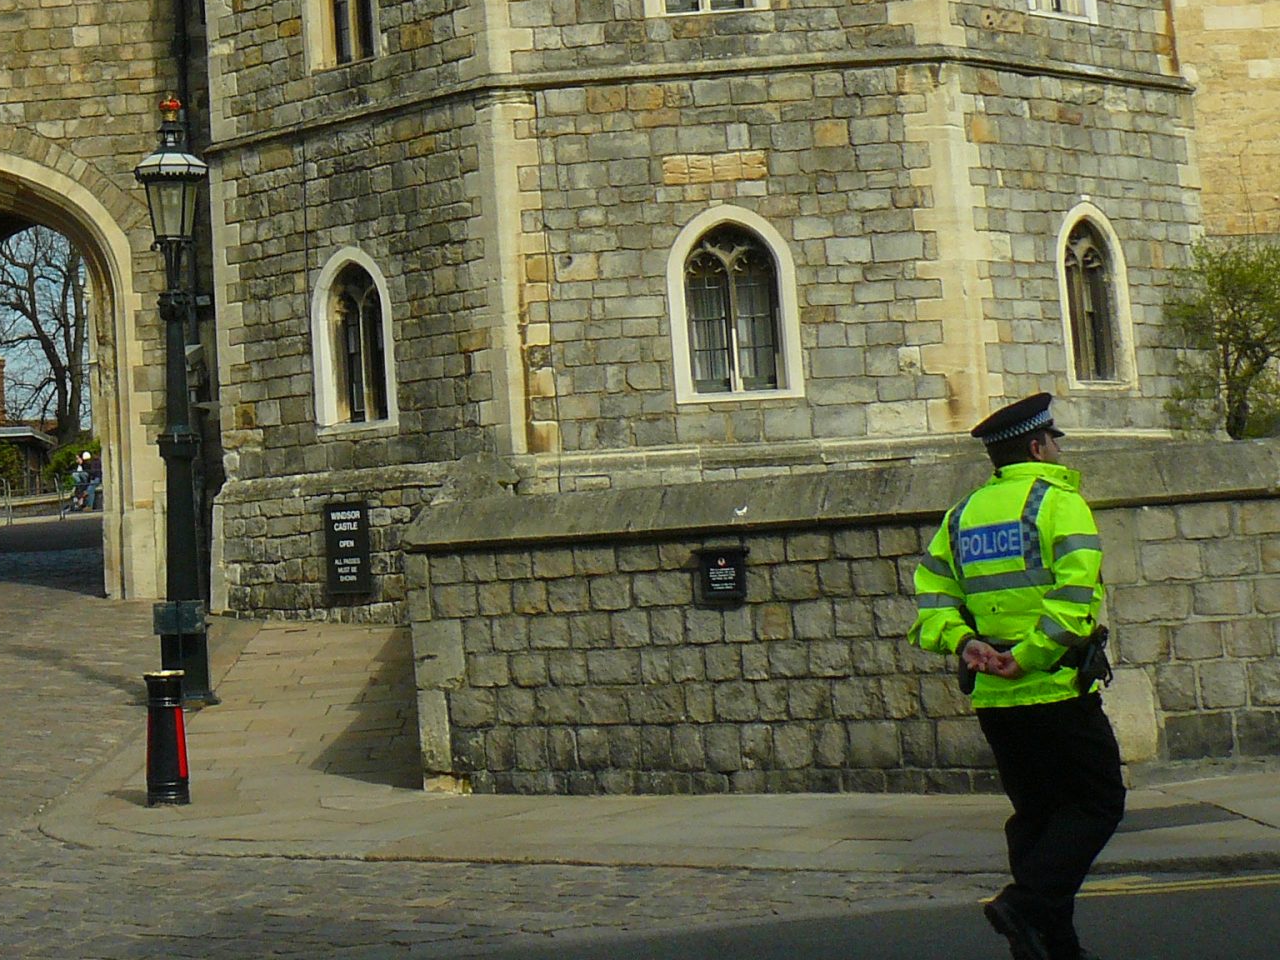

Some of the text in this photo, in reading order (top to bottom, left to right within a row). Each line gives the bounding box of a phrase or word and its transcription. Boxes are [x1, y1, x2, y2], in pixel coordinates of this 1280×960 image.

[331, 511, 360, 520] WINDSOR
[334, 522, 358, 531] CASTLE
[961, 528, 1020, 557] POLICE
